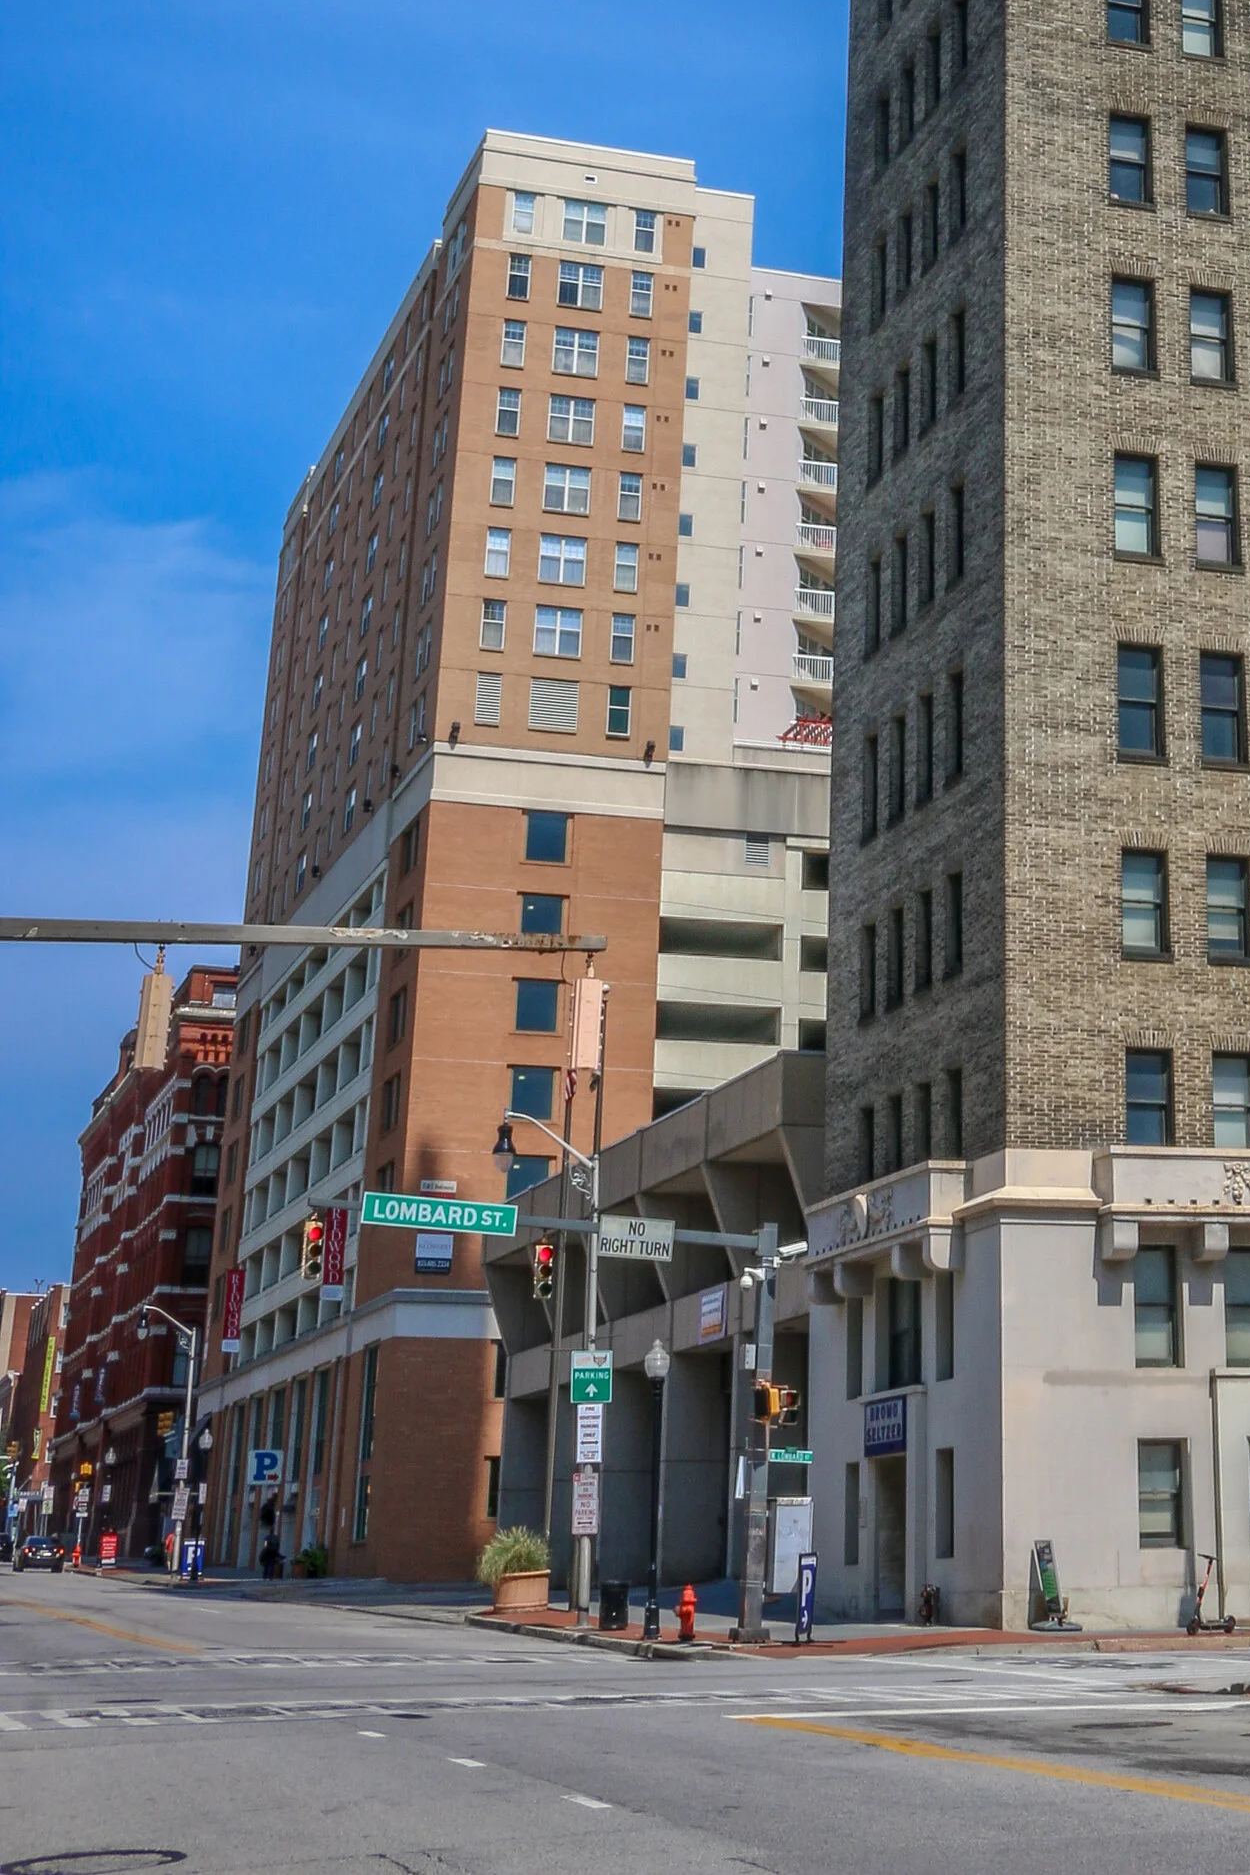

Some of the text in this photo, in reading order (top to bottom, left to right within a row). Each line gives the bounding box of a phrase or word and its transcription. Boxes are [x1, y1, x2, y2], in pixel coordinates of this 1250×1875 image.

[373, 1199, 507, 1227] LOMBARD ST.
[628, 1221, 646, 1237] NO
[327, 1208, 343, 1283] REDWOOD
[600, 1237, 670, 1257] RIGHT TURN
[227, 1274, 241, 1338] REDWOOD
[574, 1371, 610, 1380] PARKING
[869, 1401, 899, 1422] BROMO
[867, 1423, 902, 1443] SELTZER
[253, 1452, 278, 1481] P
[801, 1569, 813, 1607] P
